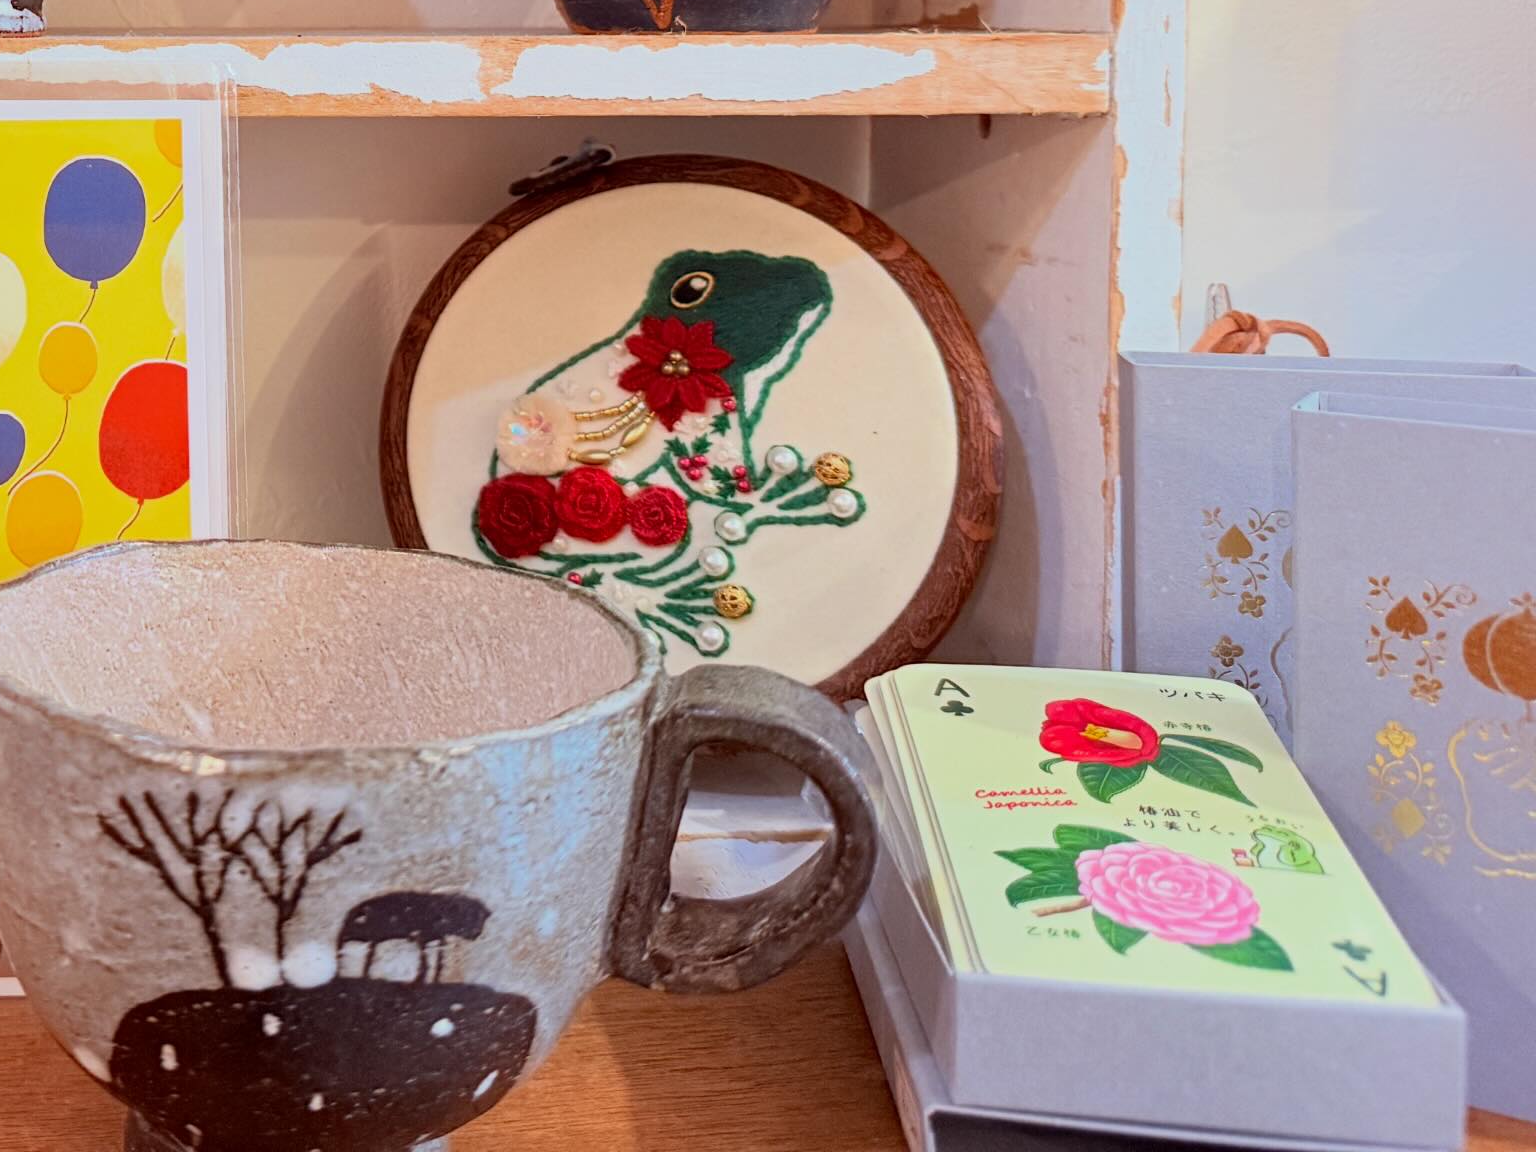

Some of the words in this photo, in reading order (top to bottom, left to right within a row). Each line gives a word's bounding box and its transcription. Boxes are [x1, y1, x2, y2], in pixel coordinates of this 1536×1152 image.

[933, 677, 971, 698] A
[1158, 687, 1228, 702] ツバキ
